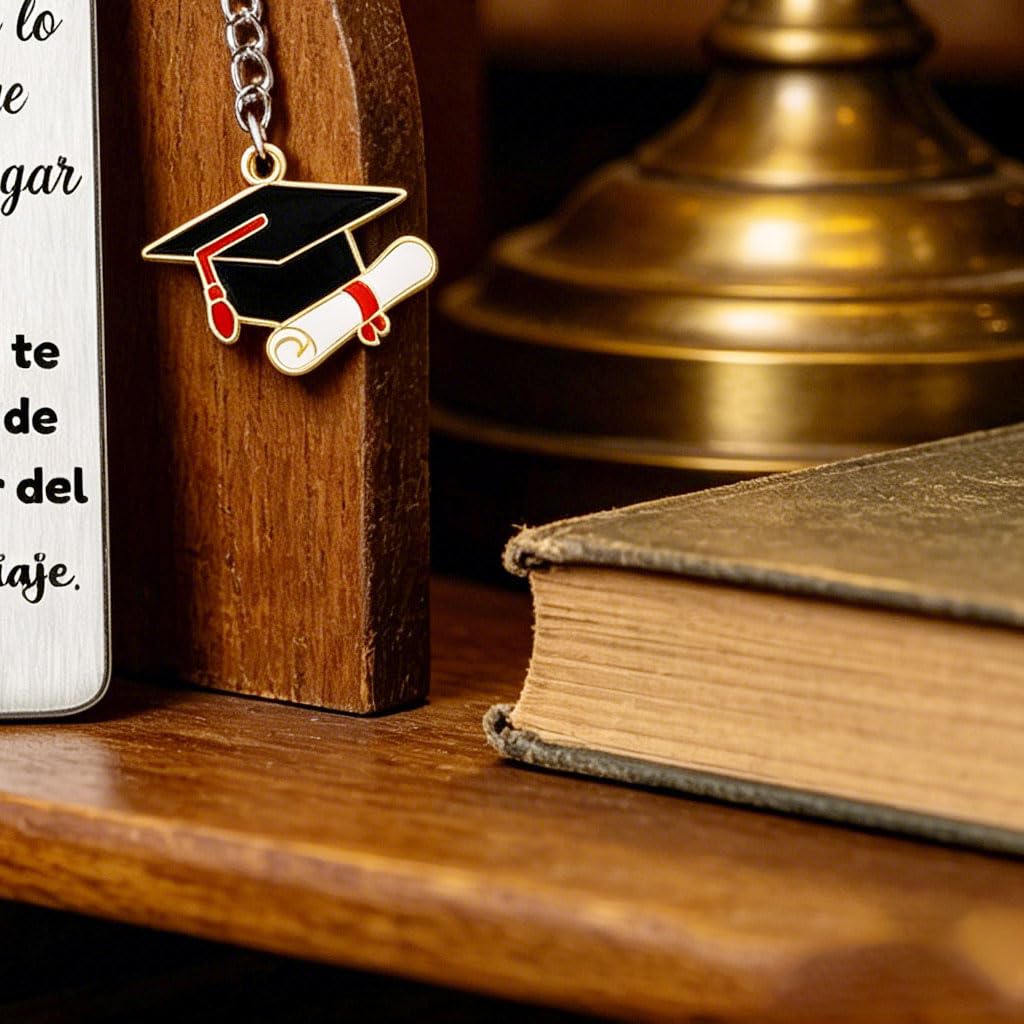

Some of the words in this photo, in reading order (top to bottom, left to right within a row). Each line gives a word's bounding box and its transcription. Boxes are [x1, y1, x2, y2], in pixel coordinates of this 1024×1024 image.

[10, 334, 61, 370] te
[3, 396, 59, 436] de
[15, 466, 89, 506] del
